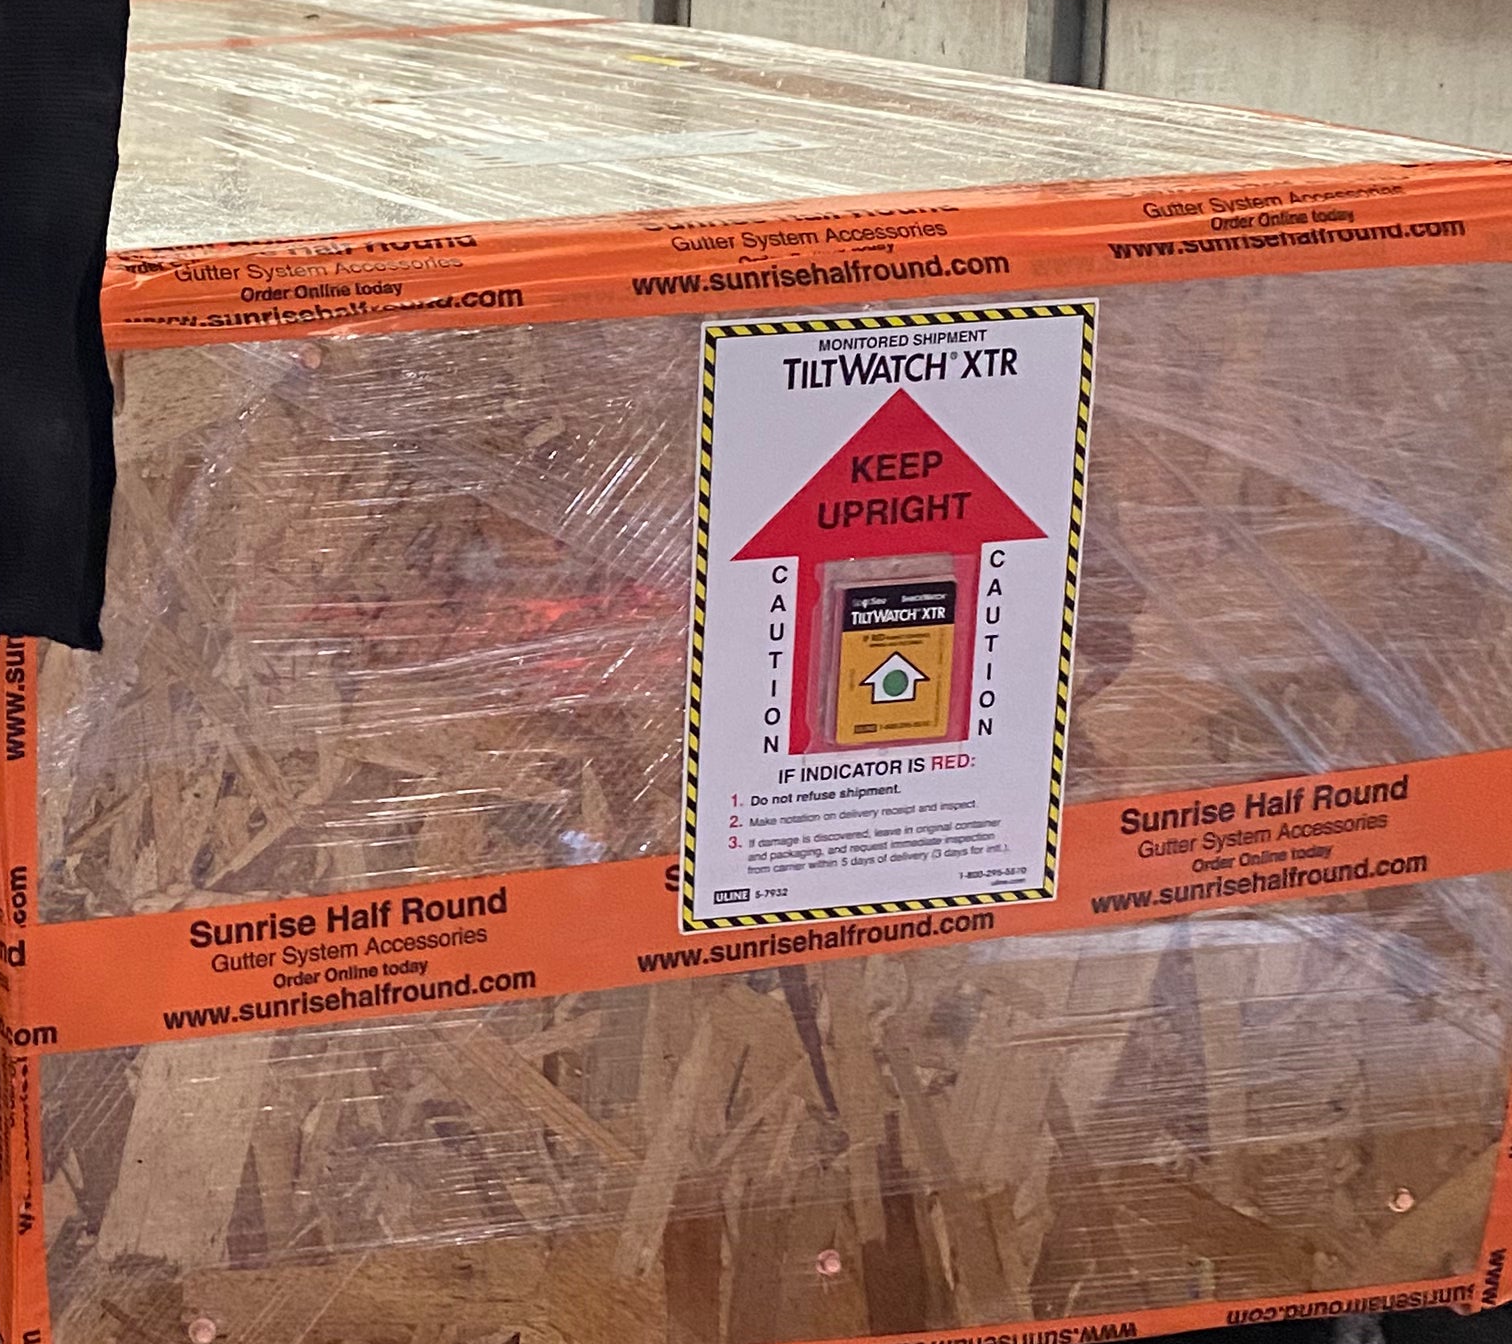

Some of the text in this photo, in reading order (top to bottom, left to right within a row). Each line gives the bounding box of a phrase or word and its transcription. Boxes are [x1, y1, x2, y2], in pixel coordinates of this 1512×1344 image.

[672, 222, 947, 251] Gutter System Accessories
[172, 257, 463, 282] Gutter System Accessories
[632, 255, 1009, 296] www.sunrisehalfround.com
[241, 281, 402, 302] Order Online today
[819, 329, 987, 351] MONITORED SHIPMENT
[961, 348, 1018, 378] XTR
[852, 451, 942, 483] KEEP
[818, 492, 971, 529] UPRIGHT
[763, 565, 788, 753] CAUTION
[978, 549, 1006, 736] CAUTION
[779, 754, 975, 784] IF INDICATOR IS RED:
[731, 784, 900, 807] 1. Do not refuse shipment.
[1121, 774, 1408, 835] Sunrise Half Round
[1138, 814, 1387, 858] Gutter System Accessories
[715, 889, 749, 903] ULINE
[1091, 855, 1427, 914] www.sunrisehalfround.com
[190, 887, 507, 948] Sunrise Half Round
[211, 927, 487, 972] Gutter System Accessories
[637, 912, 994, 972] www.sunrisehalfround.com
[273, 960, 428, 989] Order Online today
[163, 971, 535, 1030] www.sunrisehalfround.com
